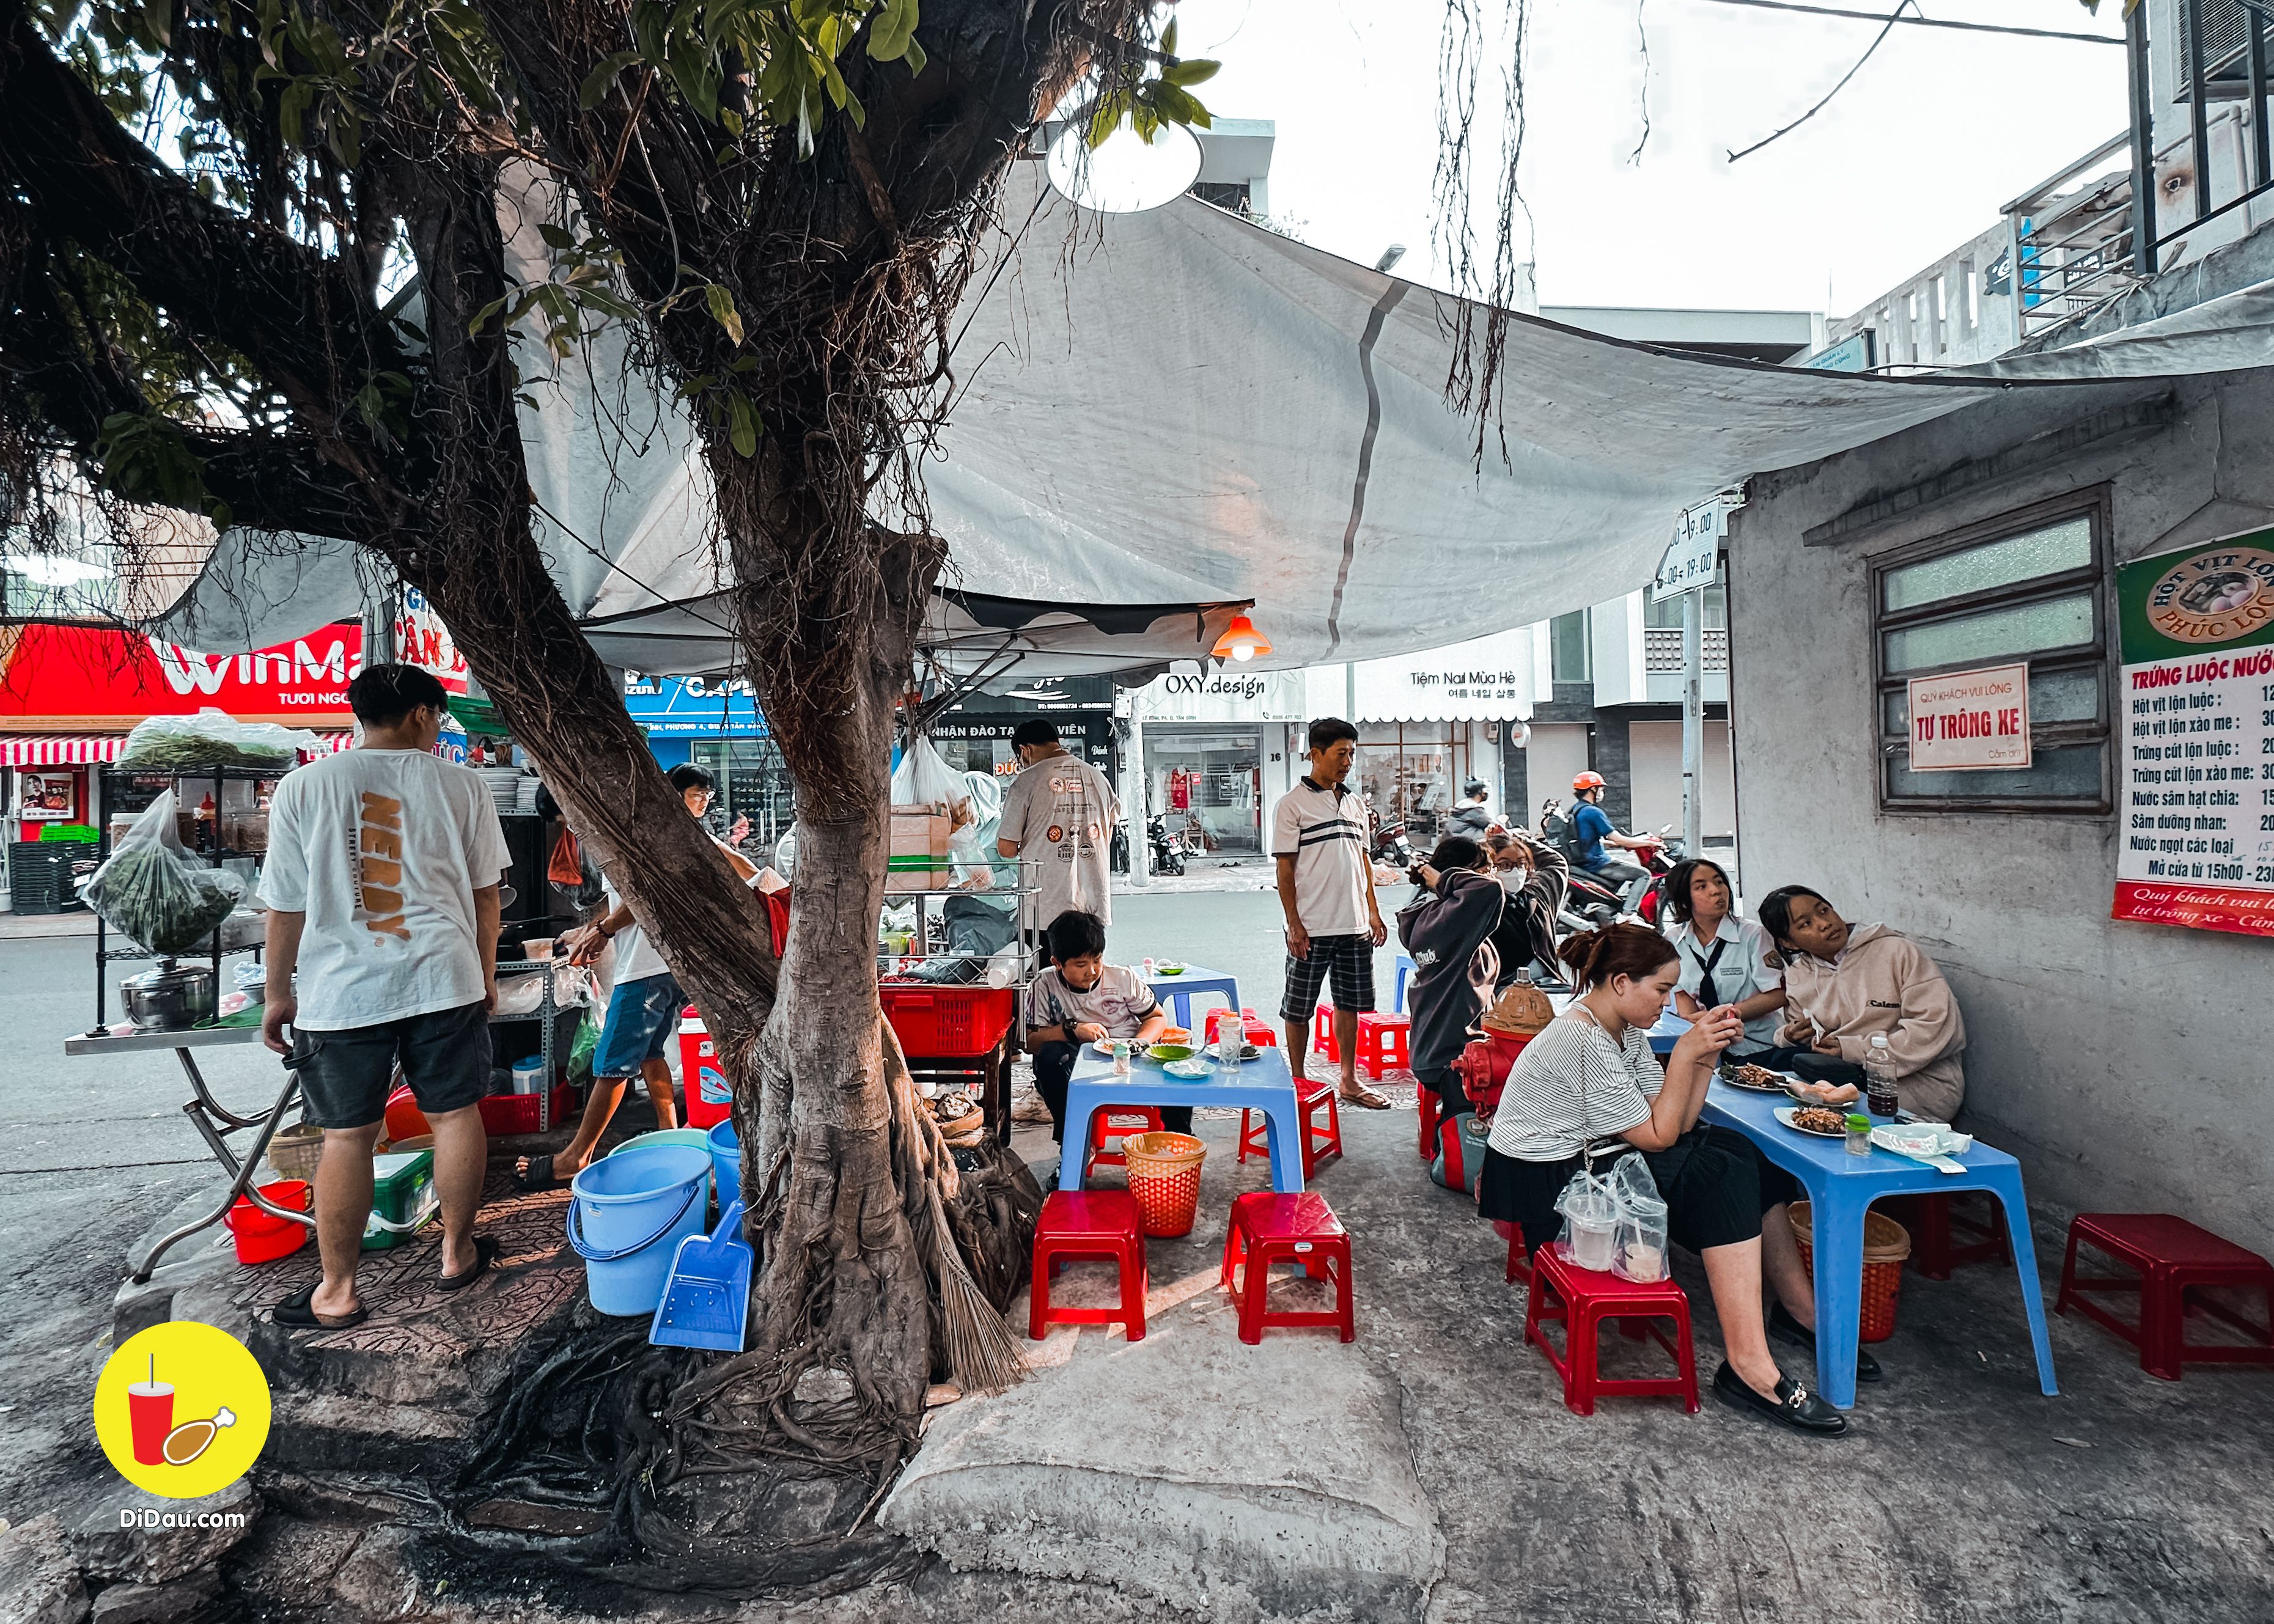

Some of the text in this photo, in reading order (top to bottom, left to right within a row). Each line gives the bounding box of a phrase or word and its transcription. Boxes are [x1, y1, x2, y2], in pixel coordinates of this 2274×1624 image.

[1687, 552, 1712, 578] 19:00
[2154, 571, 2187, 607] HỘT
[2191, 554, 2240, 572] VỊT
[2155, 611, 2225, 637] PHÚC
[1411, 670, 1516, 688] Tiệm Nail Mùa Hè
[2132, 648, 2274, 690] TRỨNG LUỘC NƯỚ
[1166, 674, 1265, 699] OXY.design
[1449, 689, 1468, 699] 여름
[1472, 689, 1492, 699] 네일
[1920, 682, 2012, 703] QUÝ KHÁCH VUI LÒNG
[2133, 698, 2149, 716] Hột
[2152, 697, 2166, 715] vịt
[2169, 695, 2185, 714] lộn
[2190, 691, 2214, 711] luộc
[970, 725, 996, 737] ĐÀO
[1057, 723, 1086, 735] VIÊN
[1917, 708, 2020, 746] TỰ TRÔNG XE
[2133, 721, 2149, 739] Hột
[2152, 720, 2166, 738] vịt
[2169, 718, 2185, 737] lộn
[2190, 716, 2210, 732] xào
[2214, 716, 2232, 730] me
[1271, 753, 1281, 762] 16
[2133, 744, 2161, 761] Trứng
[2185, 741, 2202, 761] lộn
[2206, 740, 2231, 760] luộc
[2133, 767, 2161, 784] Trứng
[2185, 766, 2202, 785] lộn
[2206, 765, 2227, 781] xào
[2231, 766, 2254, 780] me:
[2132, 790, 2158, 806] Nước
[2162, 790, 2184, 806] sâm
[2188, 790, 2206, 809] hạt
[2210, 790, 2239, 806] chia:
[2132, 814, 2154, 829] Sâm
[2158, 814, 2191, 831] dưỡng
[2195, 815, 2226, 830] nhan:
[2130, 836, 2157, 851] Nước
[2160, 837, 2184, 855] ngọt
[2187, 837, 2207, 853] các
[2211, 838, 2234, 858] loại
[361, 790, 412, 942] NERDY
[2148, 859, 2166, 875] Mở
[2168, 859, 2188, 876] cửa
[2191, 861, 2204, 878] từ
[2207, 863, 2243, 880] 15h00
[2133, 888, 2172, 905] Quý
[2173, 890, 2229, 905] khách
[2132, 905, 2152, 917] tự
[2154, 906, 2199, 924] trông
[2201, 914, 2223, 923] xe
